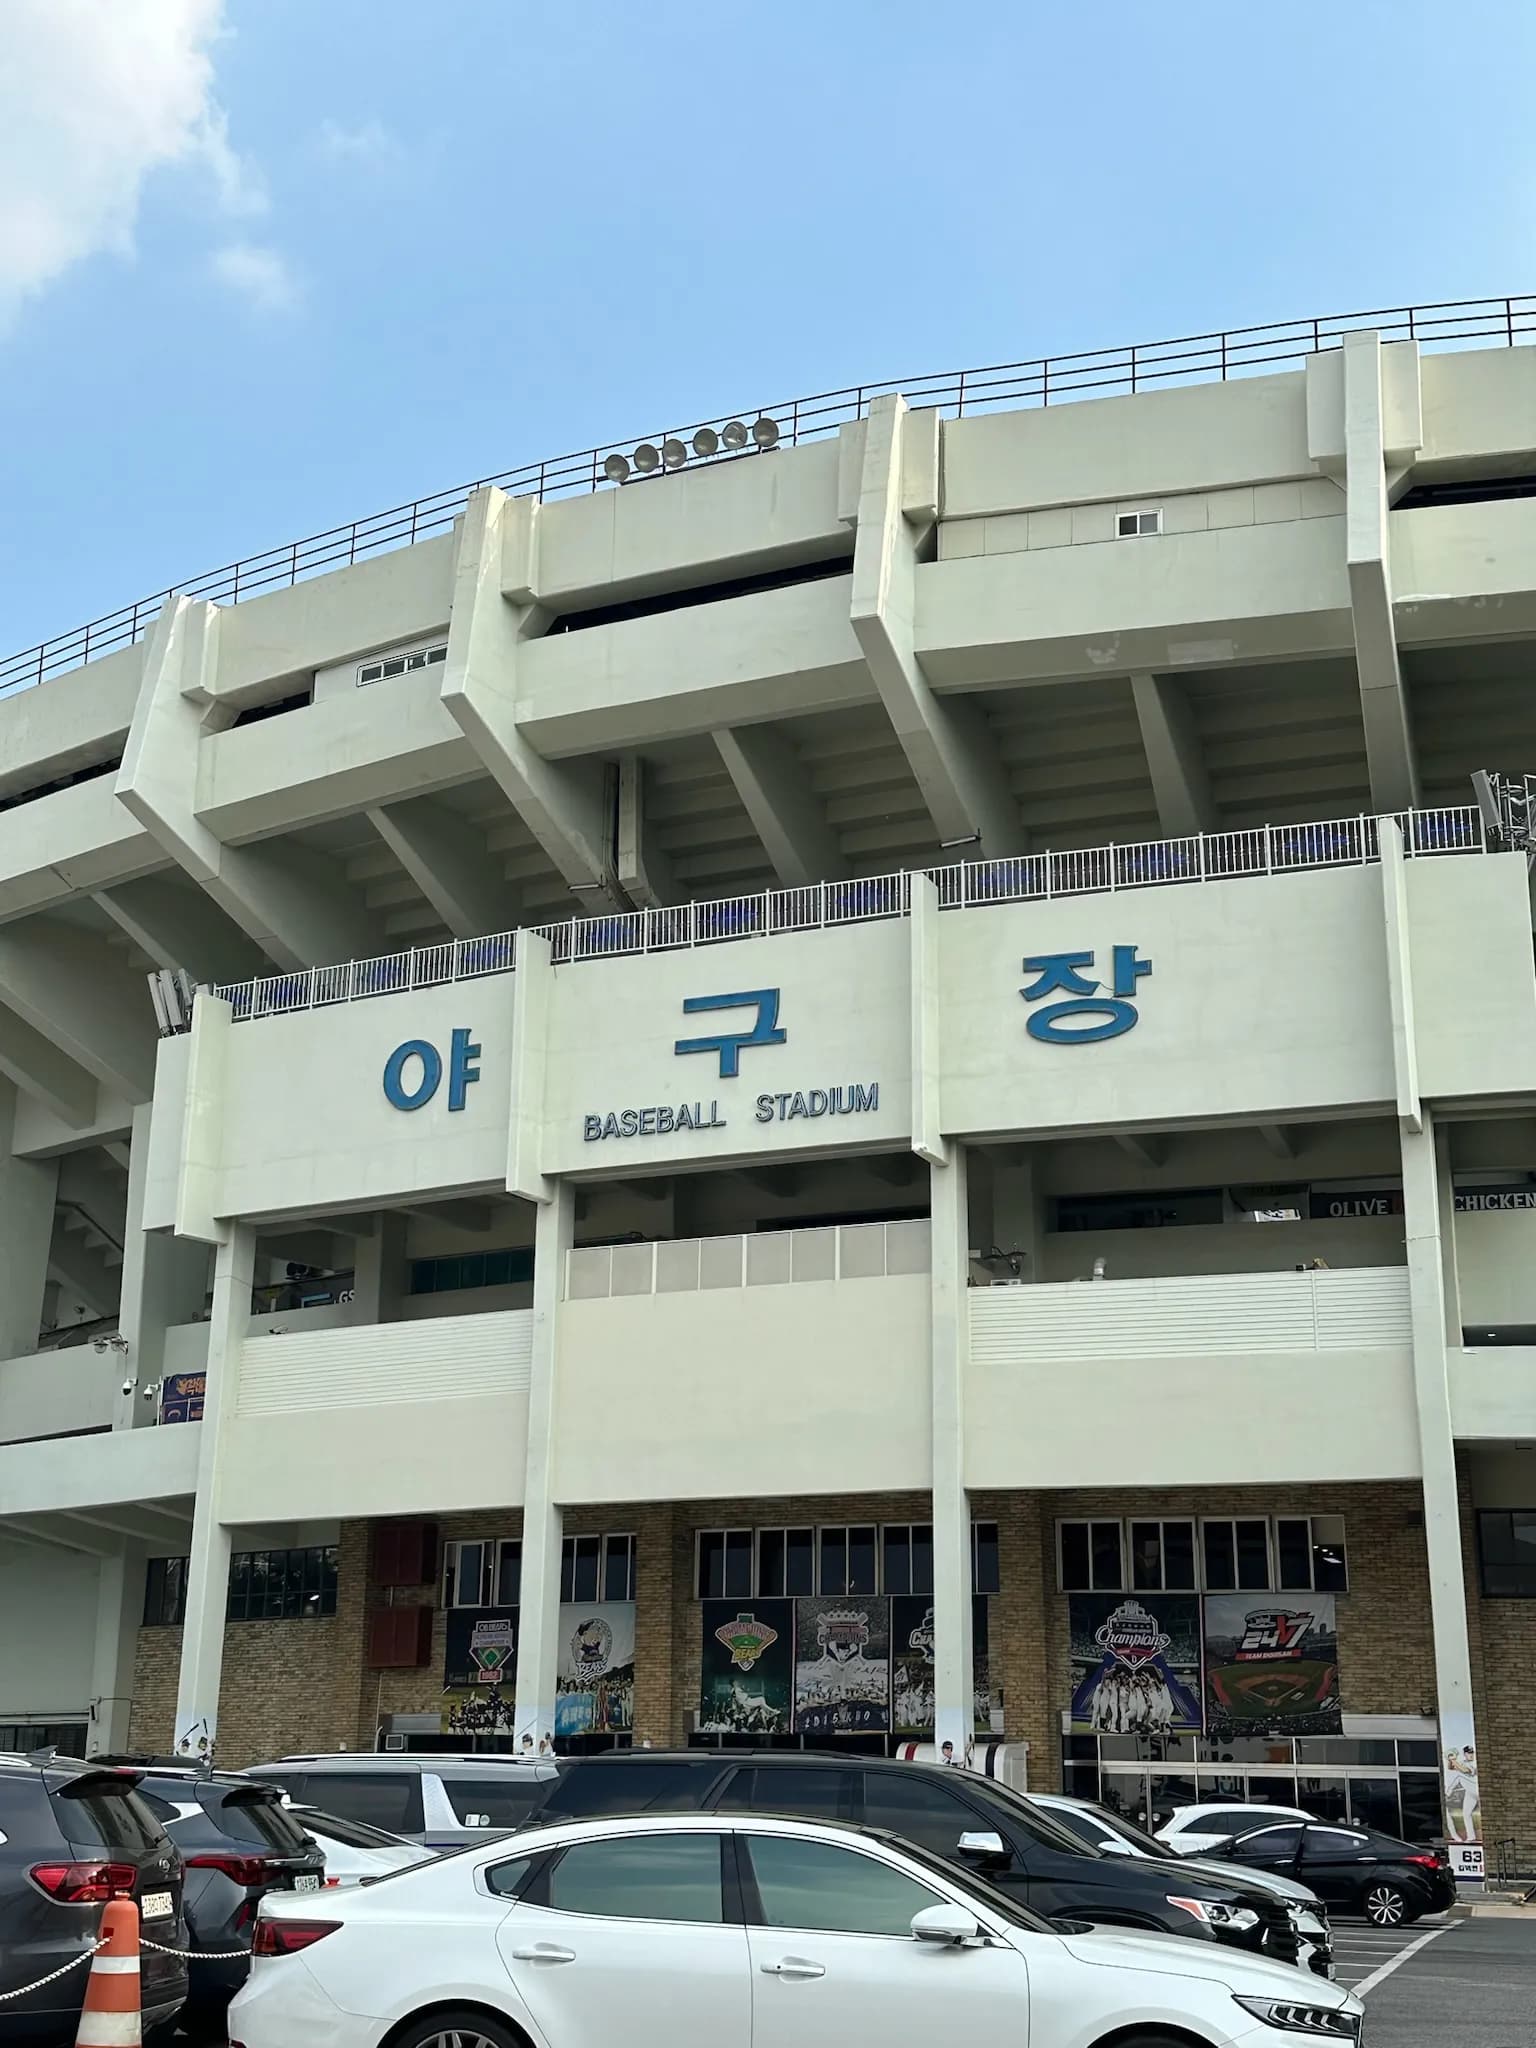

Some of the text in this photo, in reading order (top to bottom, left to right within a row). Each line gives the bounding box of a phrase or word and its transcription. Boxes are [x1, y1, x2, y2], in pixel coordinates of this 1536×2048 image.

[383, 944, 1153, 1112] 야 구 장
[583, 1083, 879, 1142] BASEBALL STADIUM
[1330, 1199, 1389, 1217] OLIVE
[1454, 1193, 1536, 1211] CHICKEN
[1097, 1627, 1168, 1649] Champions
[1462, 1851, 1482, 1863] 63
